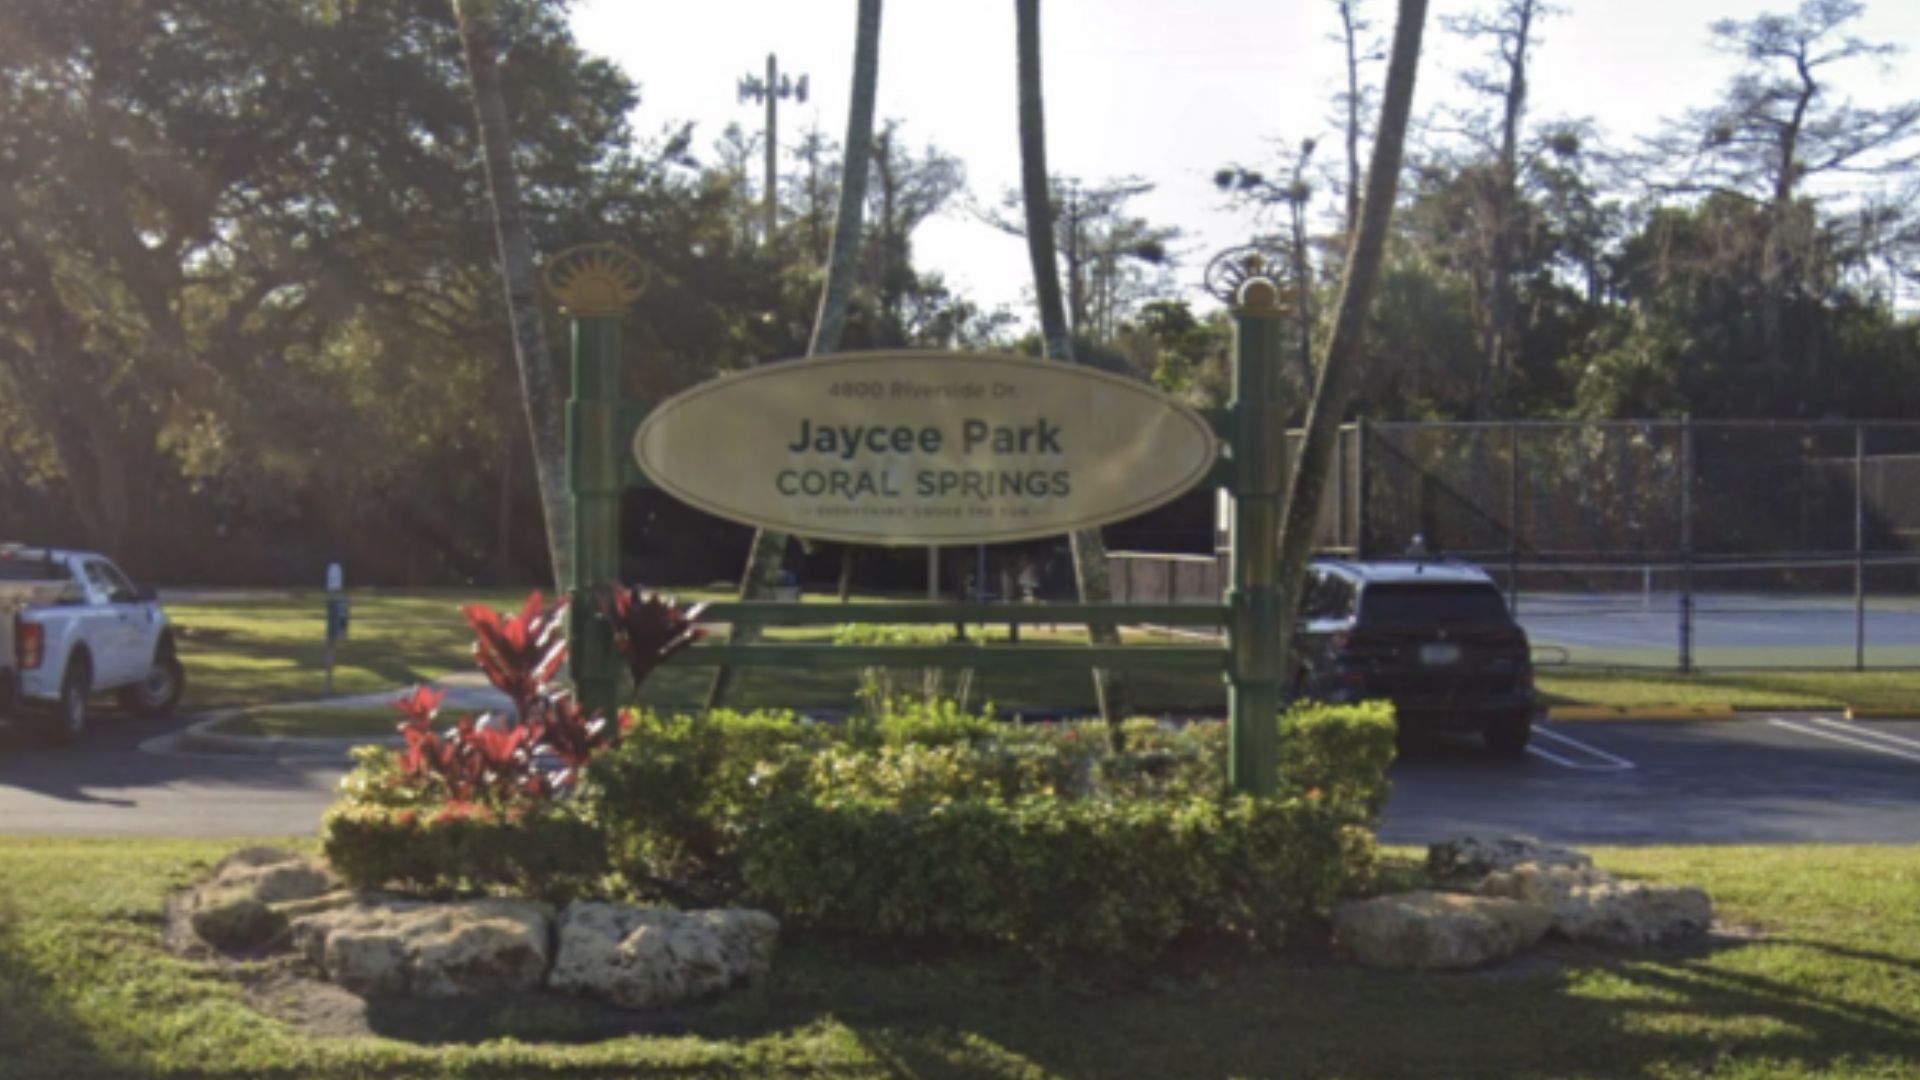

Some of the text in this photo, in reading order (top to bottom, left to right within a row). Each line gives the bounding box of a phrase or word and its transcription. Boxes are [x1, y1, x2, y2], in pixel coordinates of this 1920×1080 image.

[891, 381, 986, 398] Riverside
[788, 418, 1062, 460] Jaycee Park
[775, 470, 1071, 500] CORAL SPRINGS
